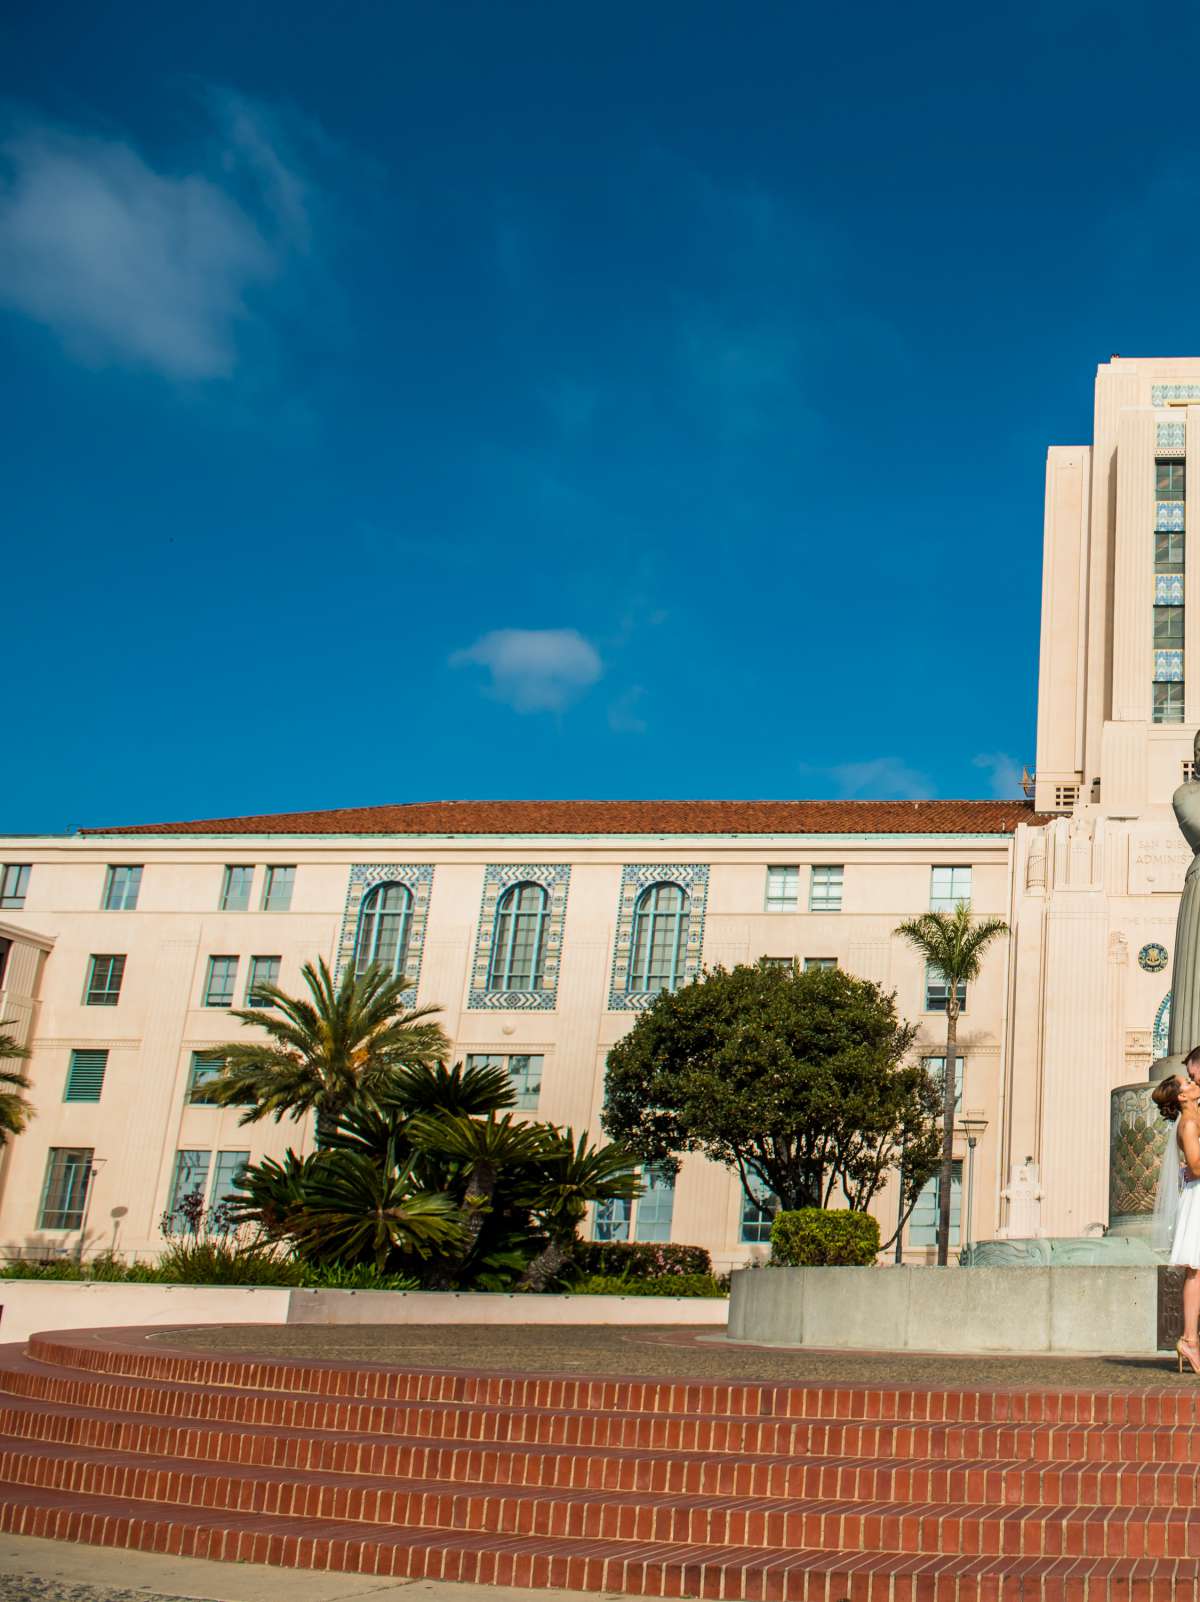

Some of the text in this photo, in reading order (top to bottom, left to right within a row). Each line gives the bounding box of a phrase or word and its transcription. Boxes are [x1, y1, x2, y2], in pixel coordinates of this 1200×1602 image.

[1138, 840, 1159, 849] SAN
[1165, 840, 1189, 849] DIEG
[1135, 854, 1194, 865] ADMINIST
